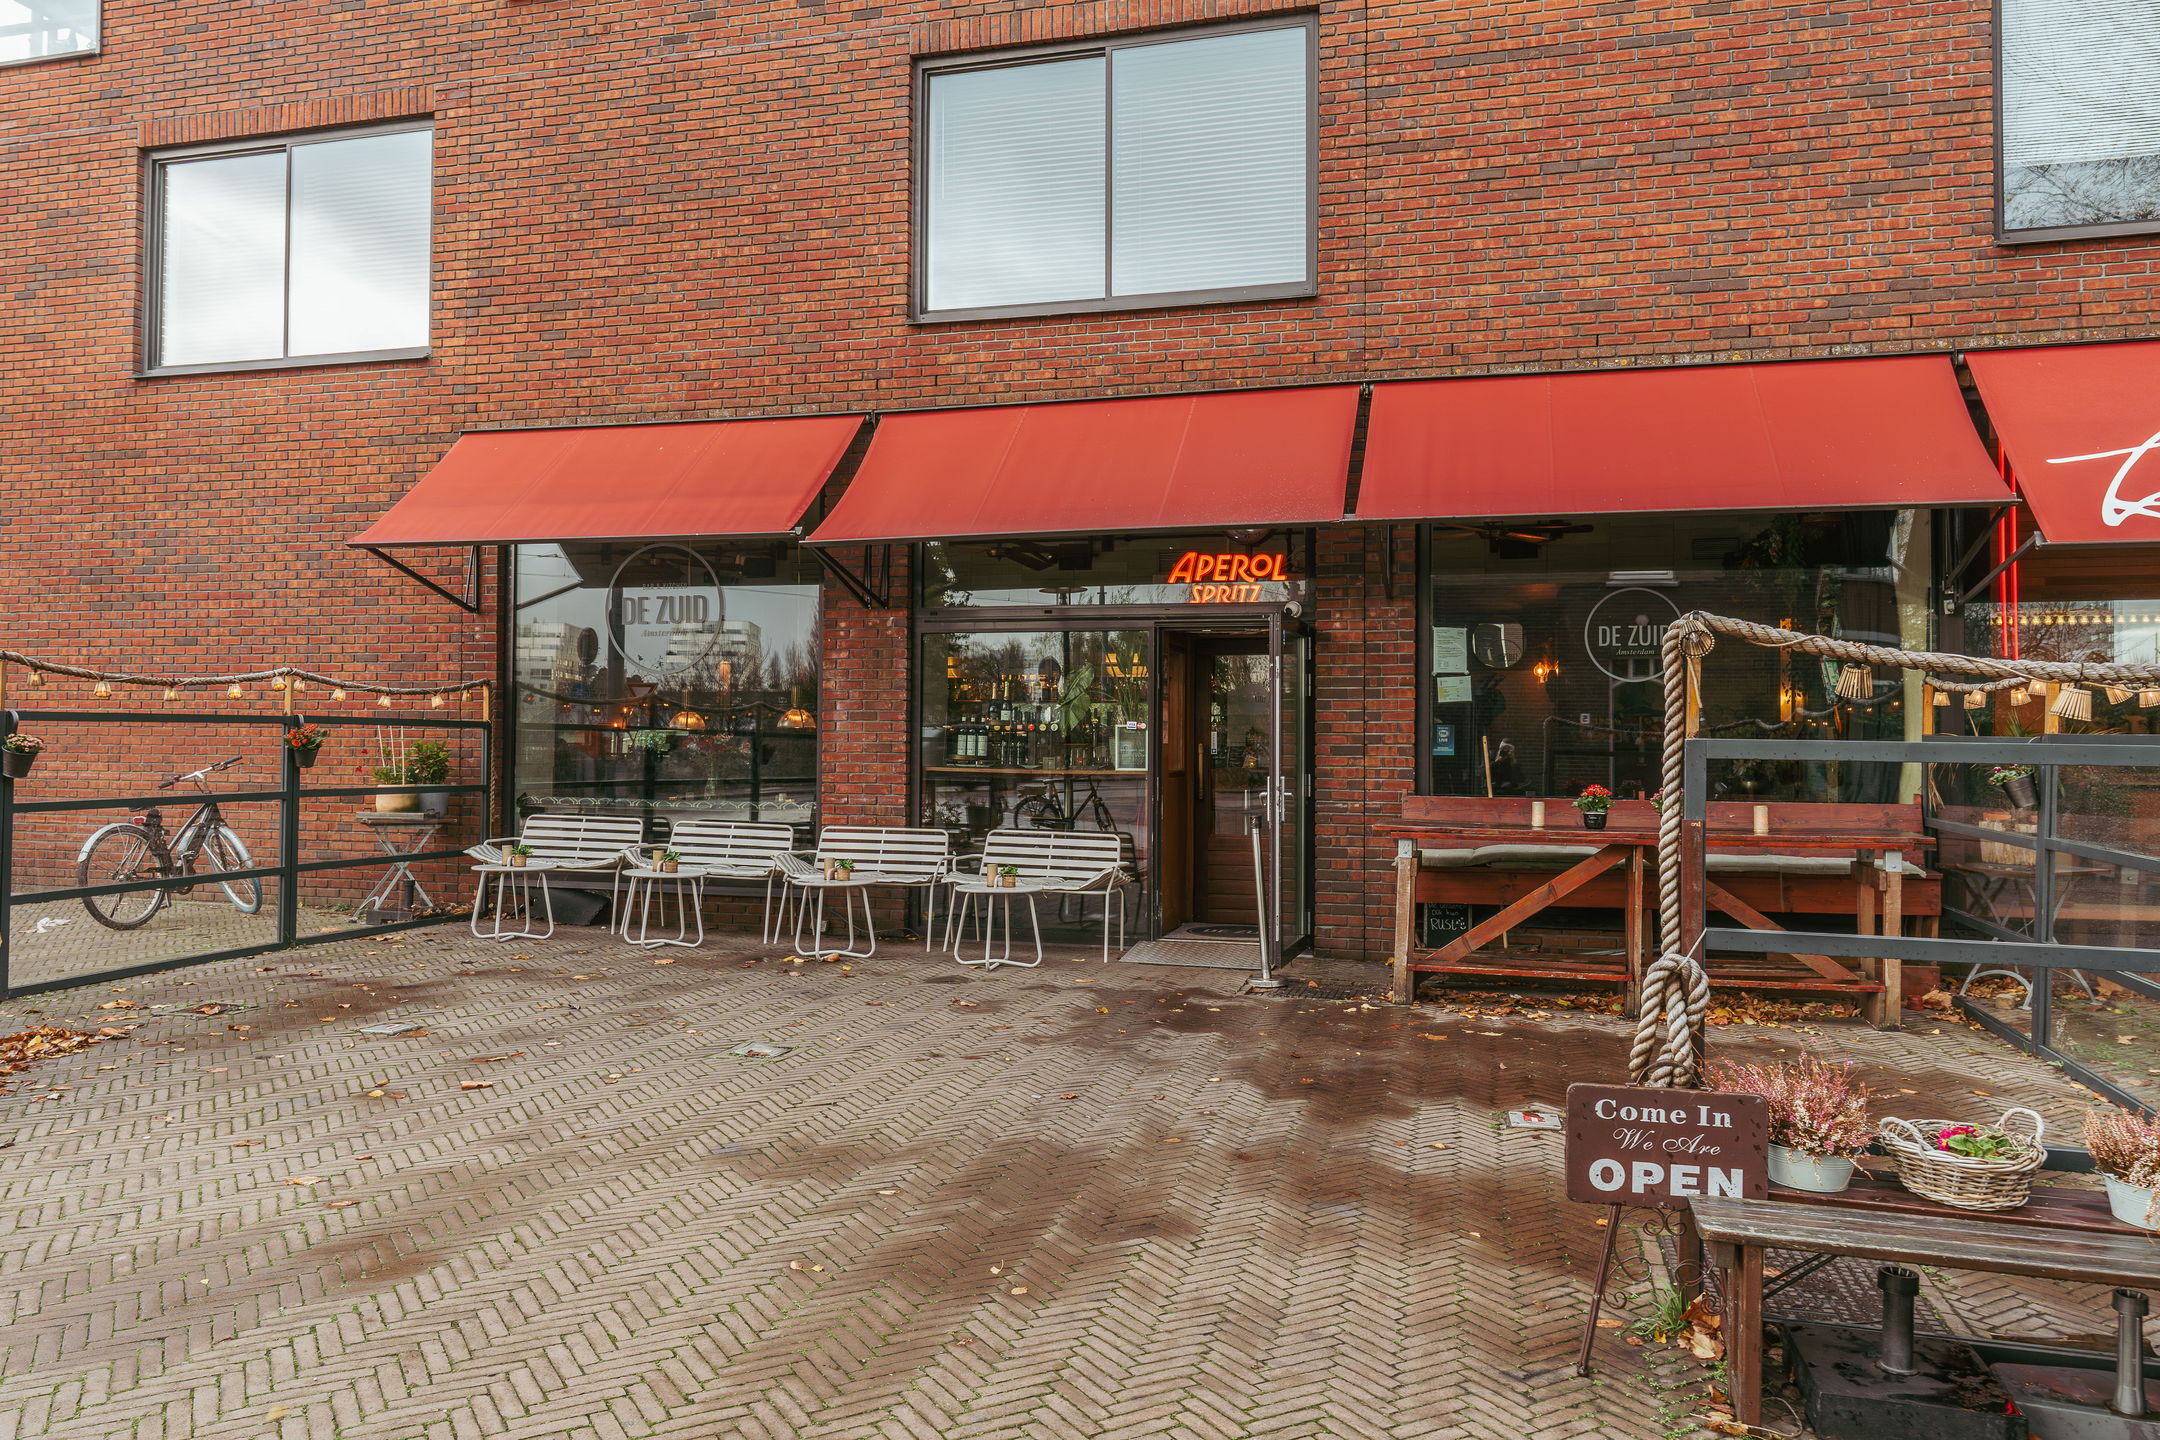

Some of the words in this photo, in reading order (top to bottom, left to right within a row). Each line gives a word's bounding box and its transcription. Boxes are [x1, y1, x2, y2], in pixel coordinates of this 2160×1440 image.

[1167, 551, 1288, 584] APEROL
[1189, 584, 1263, 604] SPRITZ
[622, 596, 650, 625] DE
[655, 594, 708, 625] ZUID
[1598, 625, 1622, 647] DE
[1594, 1098, 1688, 1125] Come
[1697, 1104, 1733, 1128] In
[1612, 1127, 1656, 1151] We
[1662, 1133, 1722, 1156] Are
[1588, 1158, 1744, 1199] OPEN
